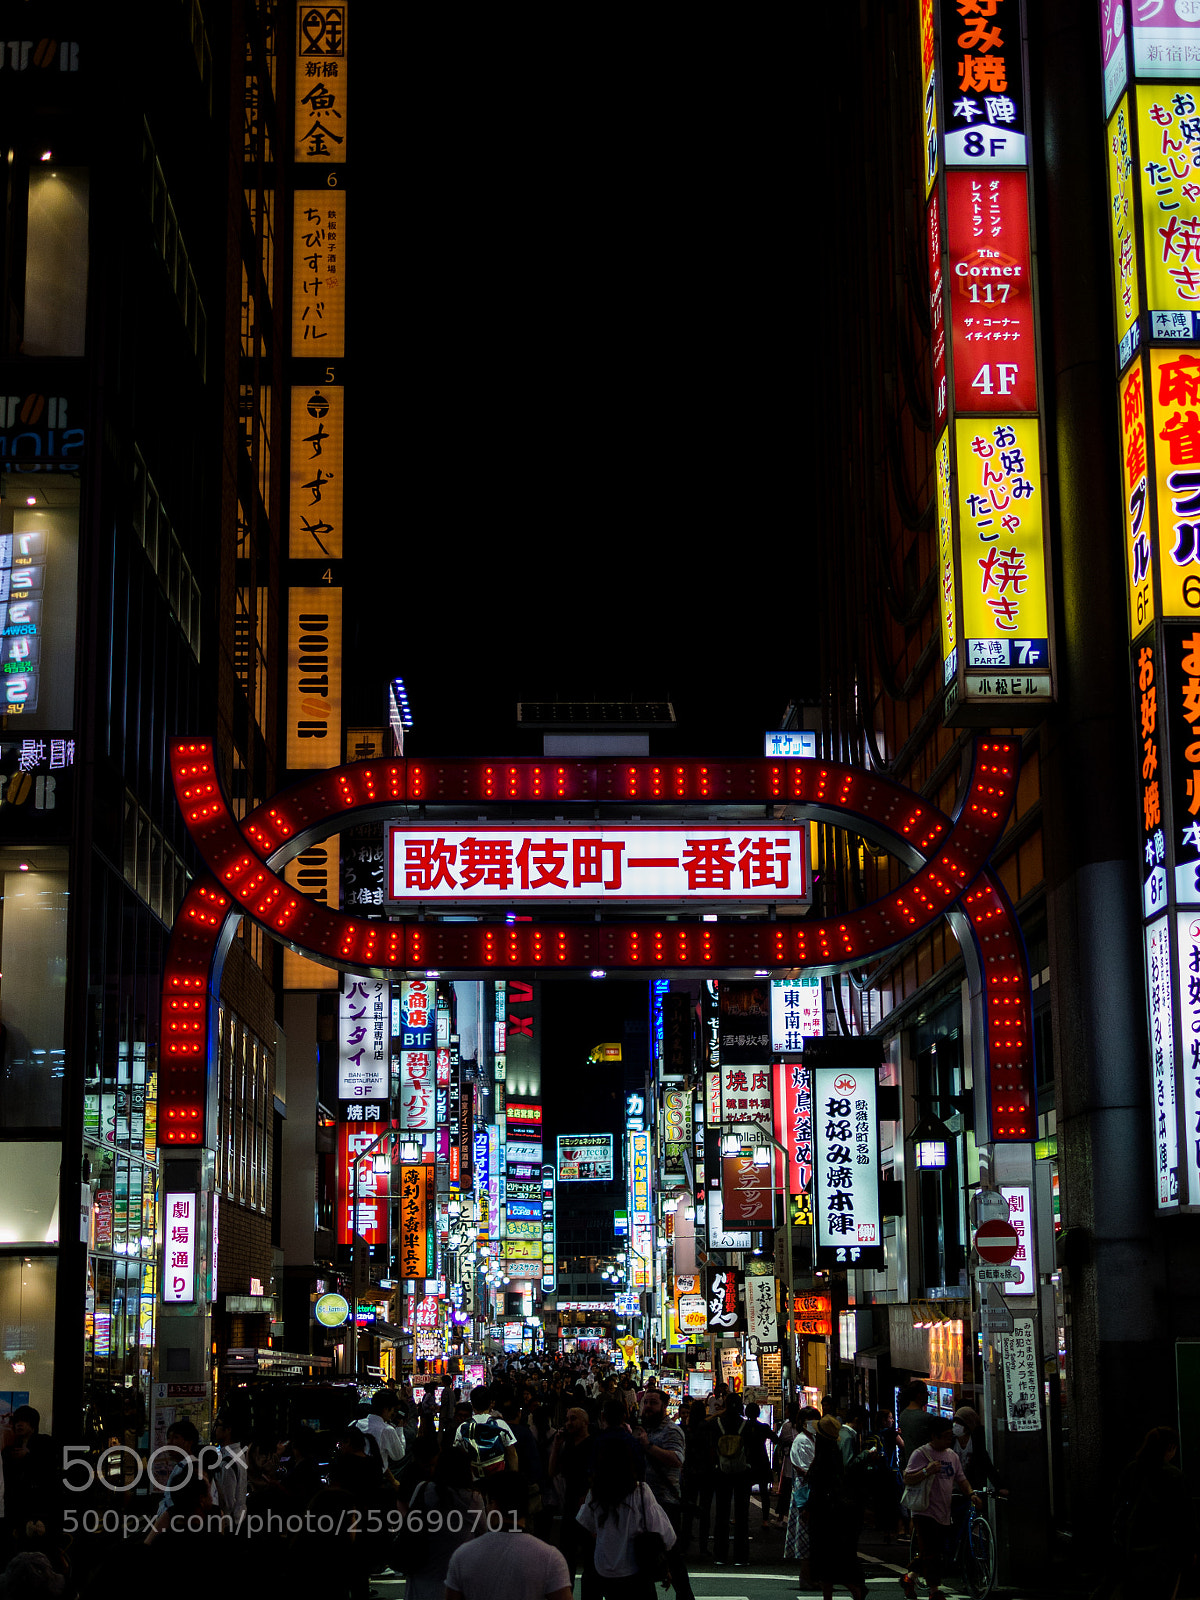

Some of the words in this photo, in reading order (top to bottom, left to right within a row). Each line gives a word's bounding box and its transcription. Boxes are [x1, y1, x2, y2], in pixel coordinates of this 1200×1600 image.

[305, 61, 339, 77] 新橋
[299, 82, 344, 156] 魚金
[953, 96, 1016, 123] 本陣
[964, 132, 1007, 158] 8F
[327, 172, 338, 187] 6
[972, 181, 983, 237] レストラン
[990, 181, 1002, 237] ダイニング
[976, 249, 1000, 258] The
[301, 208, 328, 338] ちびすけバル
[955, 263, 1022, 277] Corner
[968, 284, 1011, 304] 117
[964, 318, 1020, 327] ザ・コーナー
[1156, 313, 1187, 327] 本陣
[1157, 327, 1191, 338] PART2
[964, 332, 1021, 341] イチイチナナ
[324, 367, 335, 383] 5
[971, 364, 1019, 395] 4F
[993, 425, 1034, 499] お好み
[300, 423, 334, 556] すずや
[971, 437, 1021, 535] もんじゃ
[967, 495, 1001, 543] たこ
[321, 568, 333, 583] 4
[978, 547, 1028, 632] 焼き
[1137, 583, 1149, 626] 6F
[972, 640, 1004, 656] 本陣
[973, 656, 1006, 665] PART2
[1015, 641, 1039, 665] 7F
[297, 614, 331, 739] DOUTOR
[978, 678, 1038, 695] 小松ビル
[404, 836, 791, 891] 歌舞伎町一番街
[1150, 874, 1164, 905] 8F
[346, 982, 370, 1067] バンタイ
[373, 982, 384, 1061] タイ国料理専門店
[784, 990, 802, 1050] 東南荘
[404, 1033, 432, 1046] B1F
[354, 1086, 373, 1096] 3F
[726, 1070, 770, 1092] 焼肉
[347, 1105, 381, 1121] 焼肉
[825, 1097, 856, 1236] お好み焼本陣
[172, 1201, 190, 1293] 劇場通り
[836, 1247, 861, 1262] 2F
[978, 1269, 1018, 1280] 自転車を除く
[1024, 1323, 1037, 1417] みなさまの安全を守ります
